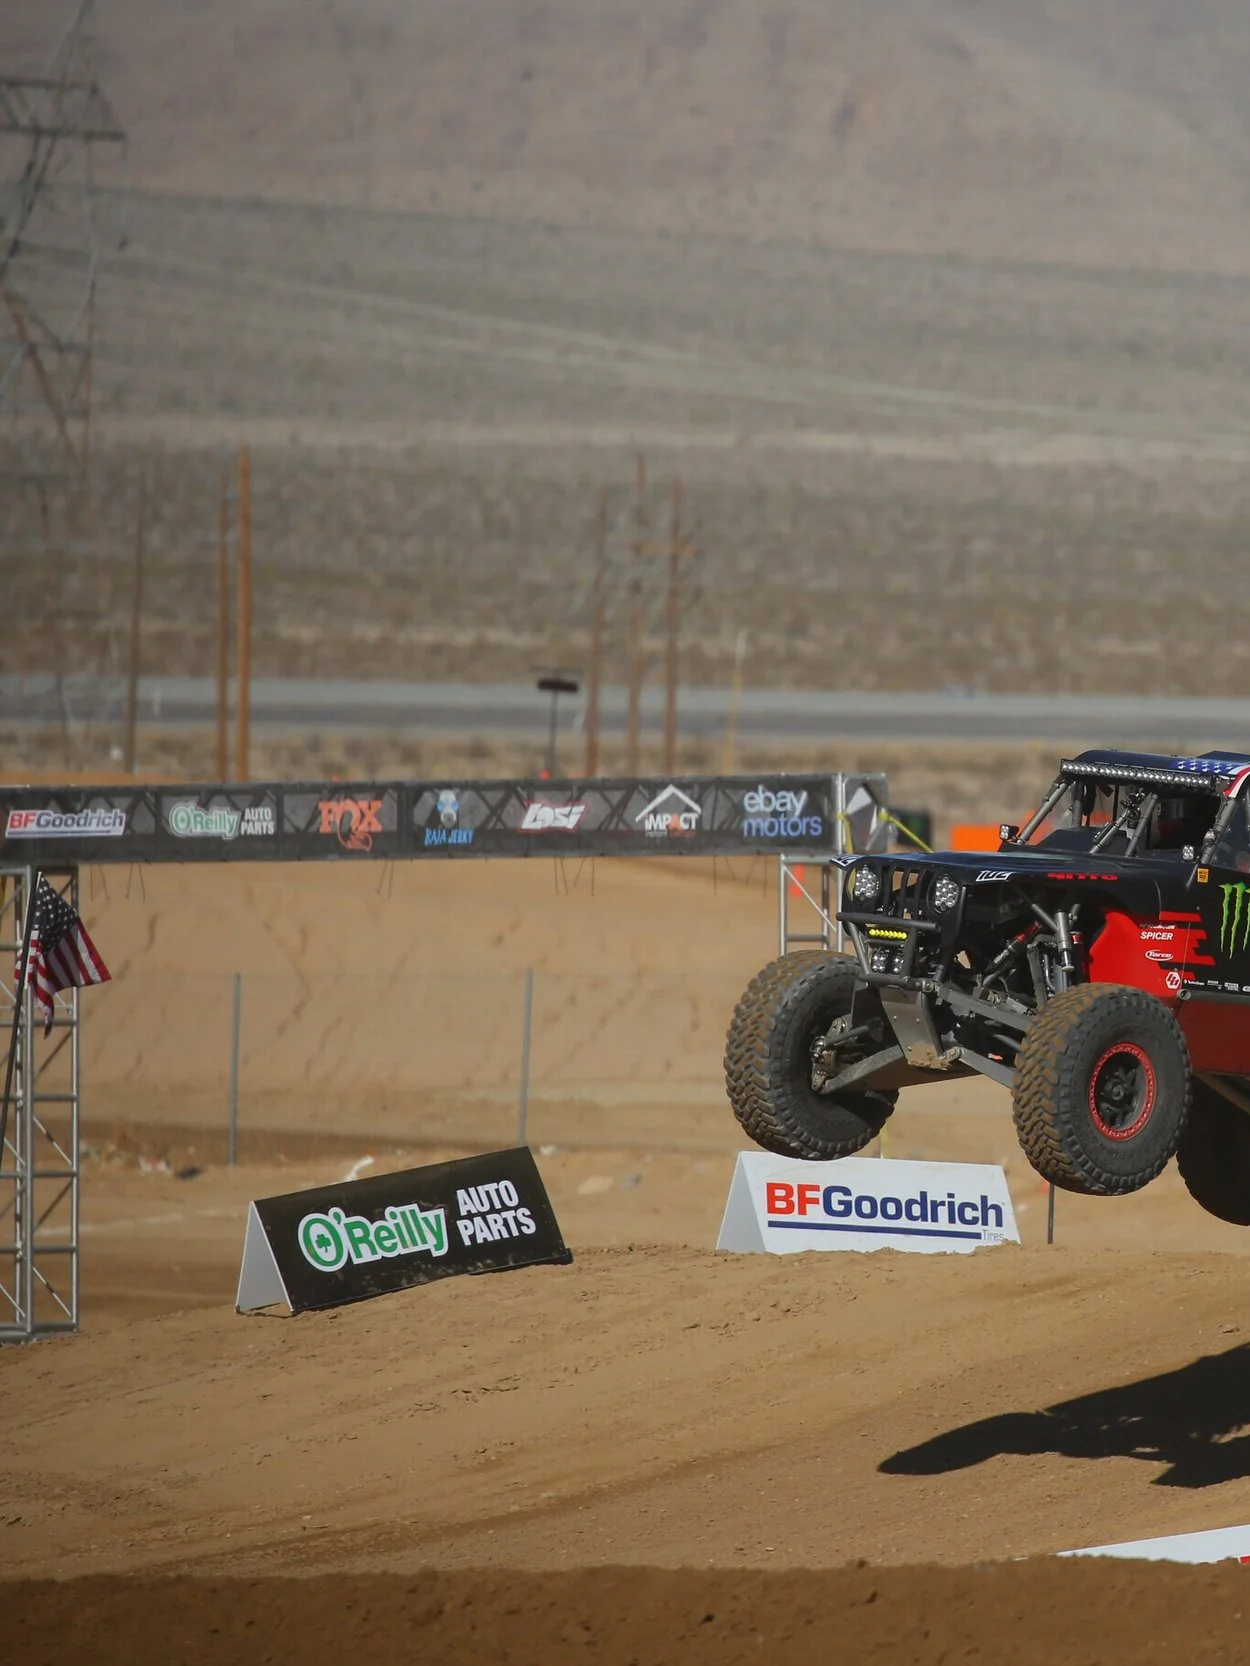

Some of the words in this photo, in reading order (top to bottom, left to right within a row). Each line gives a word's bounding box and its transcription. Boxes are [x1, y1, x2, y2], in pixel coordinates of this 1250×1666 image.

[244, 807, 272, 822] AUTO
[744, 784, 808, 816] ebay
[8, 808, 125, 829] BFGoodrich
[170, 803, 241, 840] O'Reilly
[241, 820, 274, 836] PARTS
[319, 799, 382, 851] FOX
[743, 813, 823, 837] motors
[448, 830, 474, 844] JERKY
[1140, 931, 1174, 940] SPICER
[456, 1180, 519, 1217] AUTO
[766, 1182, 1003, 1228] BFGoodrich
[299, 1206, 448, 1272] O'Reilly
[456, 1208, 537, 1246] PARTS
